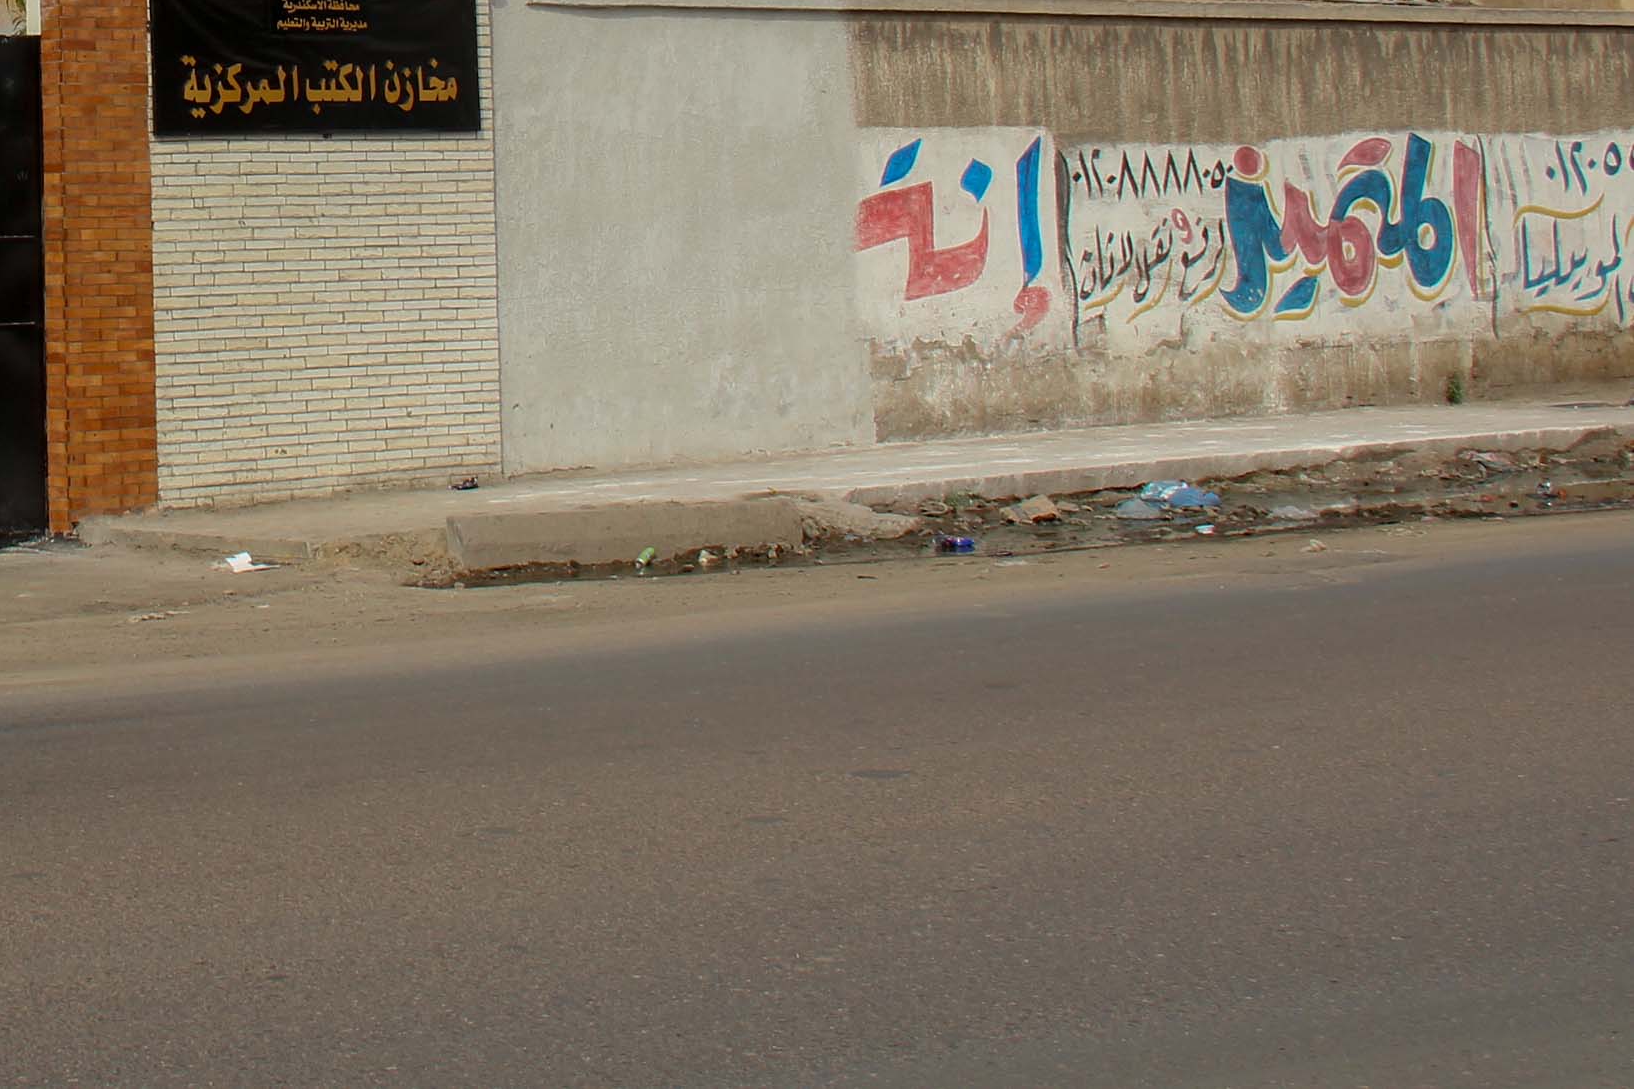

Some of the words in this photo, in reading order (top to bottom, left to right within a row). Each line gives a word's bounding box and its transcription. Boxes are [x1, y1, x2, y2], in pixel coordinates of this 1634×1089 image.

[276, 17, 310, 31] والتعليم
[311, 17, 339, 31] التربية
[340, 17, 368, 32] مديرية
[179, 54, 299, 119] المركزية
[305, 59, 376, 115] الكتب
[384, 56, 458, 113] مخازن
[1221, 132, 1480, 314] المتميز
